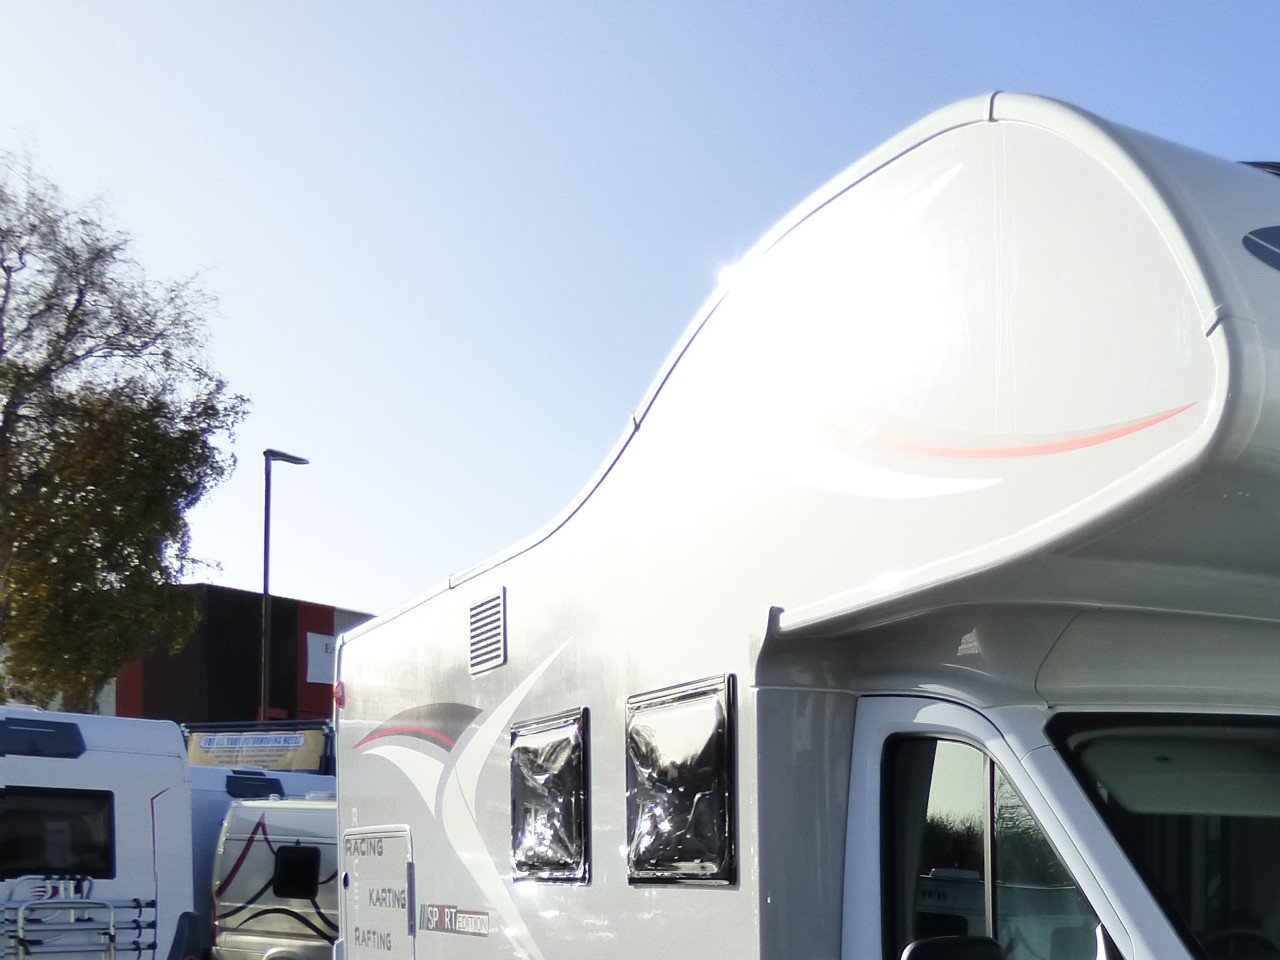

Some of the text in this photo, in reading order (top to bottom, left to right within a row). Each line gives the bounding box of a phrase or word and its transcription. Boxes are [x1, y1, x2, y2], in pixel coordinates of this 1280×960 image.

[345, 838, 383, 857] RACING
[368, 887, 407, 909] KARTING
[354, 926, 392, 952] RAFTING
